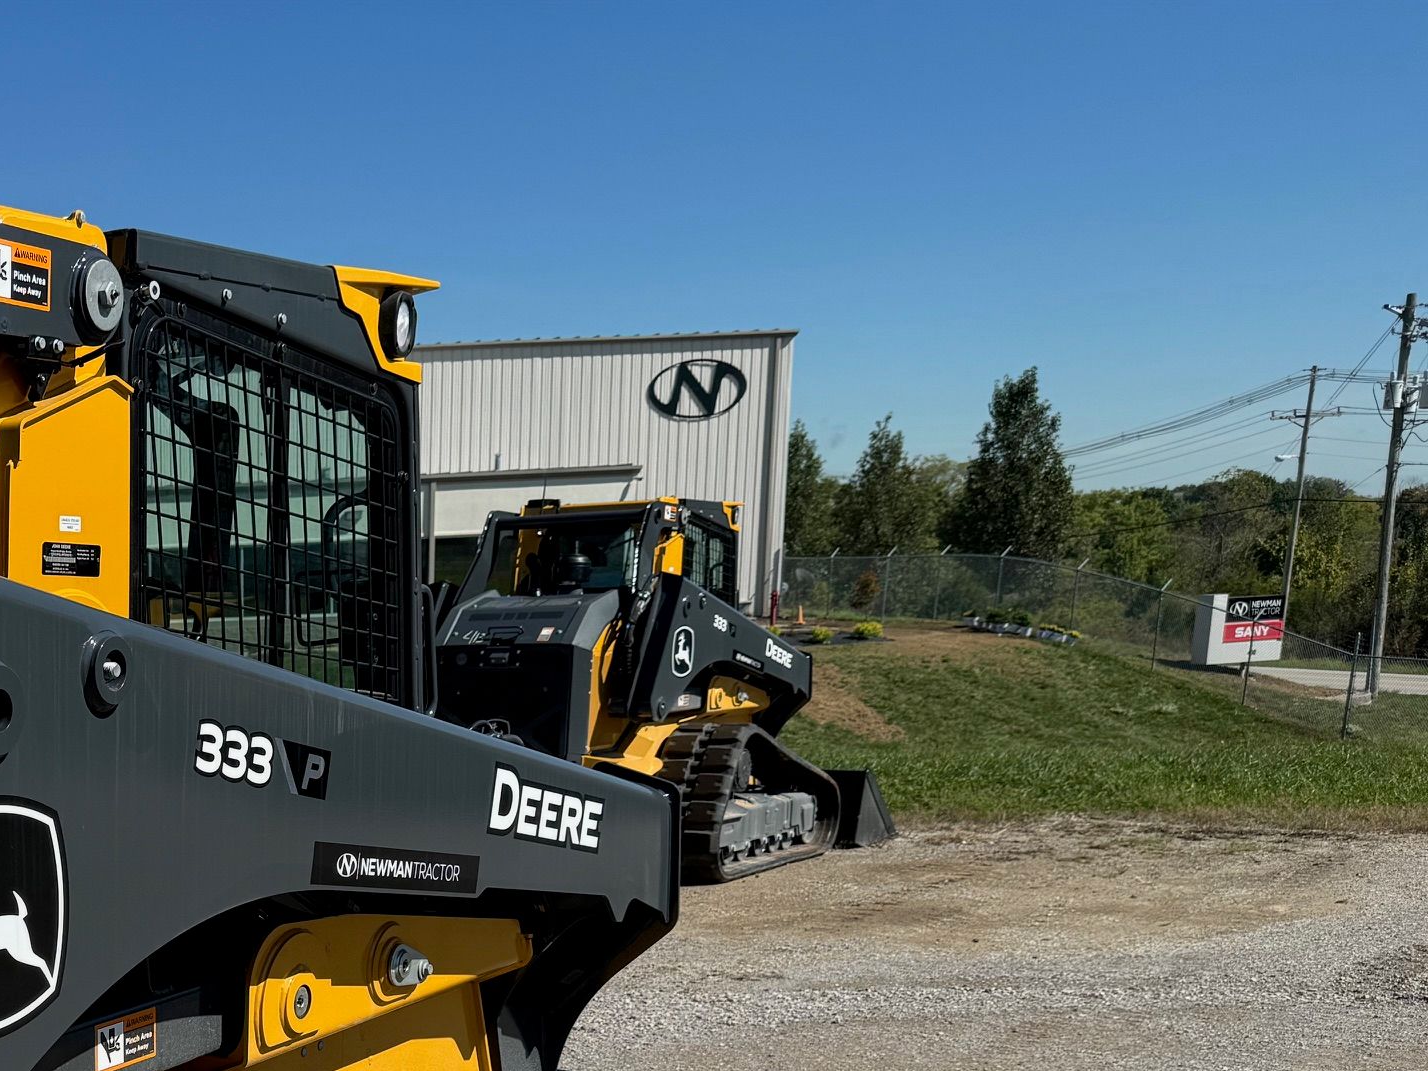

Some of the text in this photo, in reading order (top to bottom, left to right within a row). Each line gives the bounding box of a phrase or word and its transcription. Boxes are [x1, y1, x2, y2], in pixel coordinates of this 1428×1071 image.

[20, 250, 48, 264] WARNING
[13, 270, 46, 286] Pinch Area
[13, 283, 42, 299] Keep Away
[1252, 599, 1282, 608] NEWMAN
[713, 614, 728, 632] 333
[1234, 626, 1270, 638] SANY
[765, 638, 793, 669] DEERE
[195, 722, 325, 790] 333 P
[489, 767, 604, 848] DEERE
[125, 1031, 153, 1045] Pinch Area
[125, 1043, 149, 1056] Keep Away
